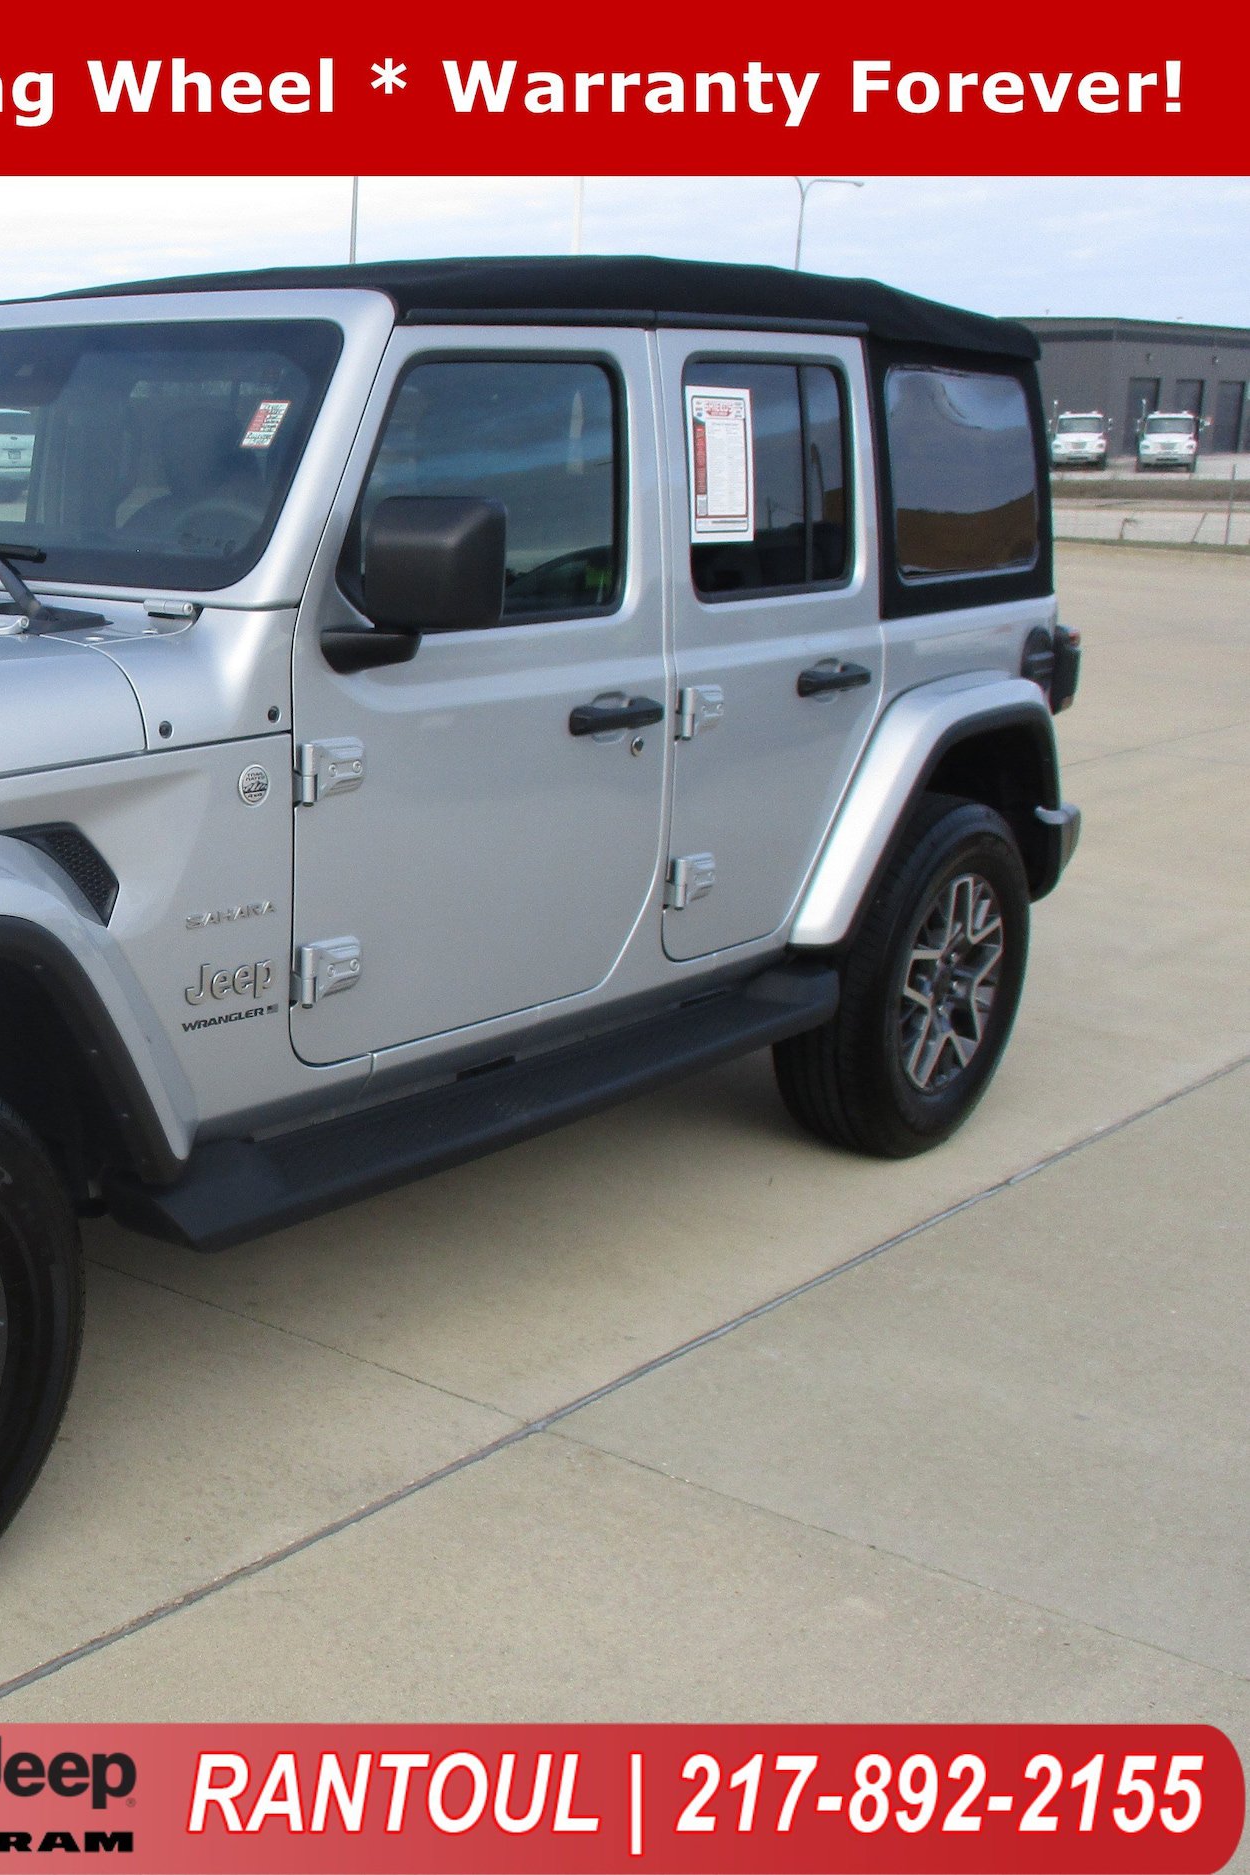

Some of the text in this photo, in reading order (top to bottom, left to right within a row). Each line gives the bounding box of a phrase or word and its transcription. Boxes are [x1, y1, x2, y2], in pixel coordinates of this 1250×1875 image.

[186, 900, 277, 930] SAHARA
[185, 959, 275, 1006] Jeep
[181, 1006, 264, 1032] WRANGLER
